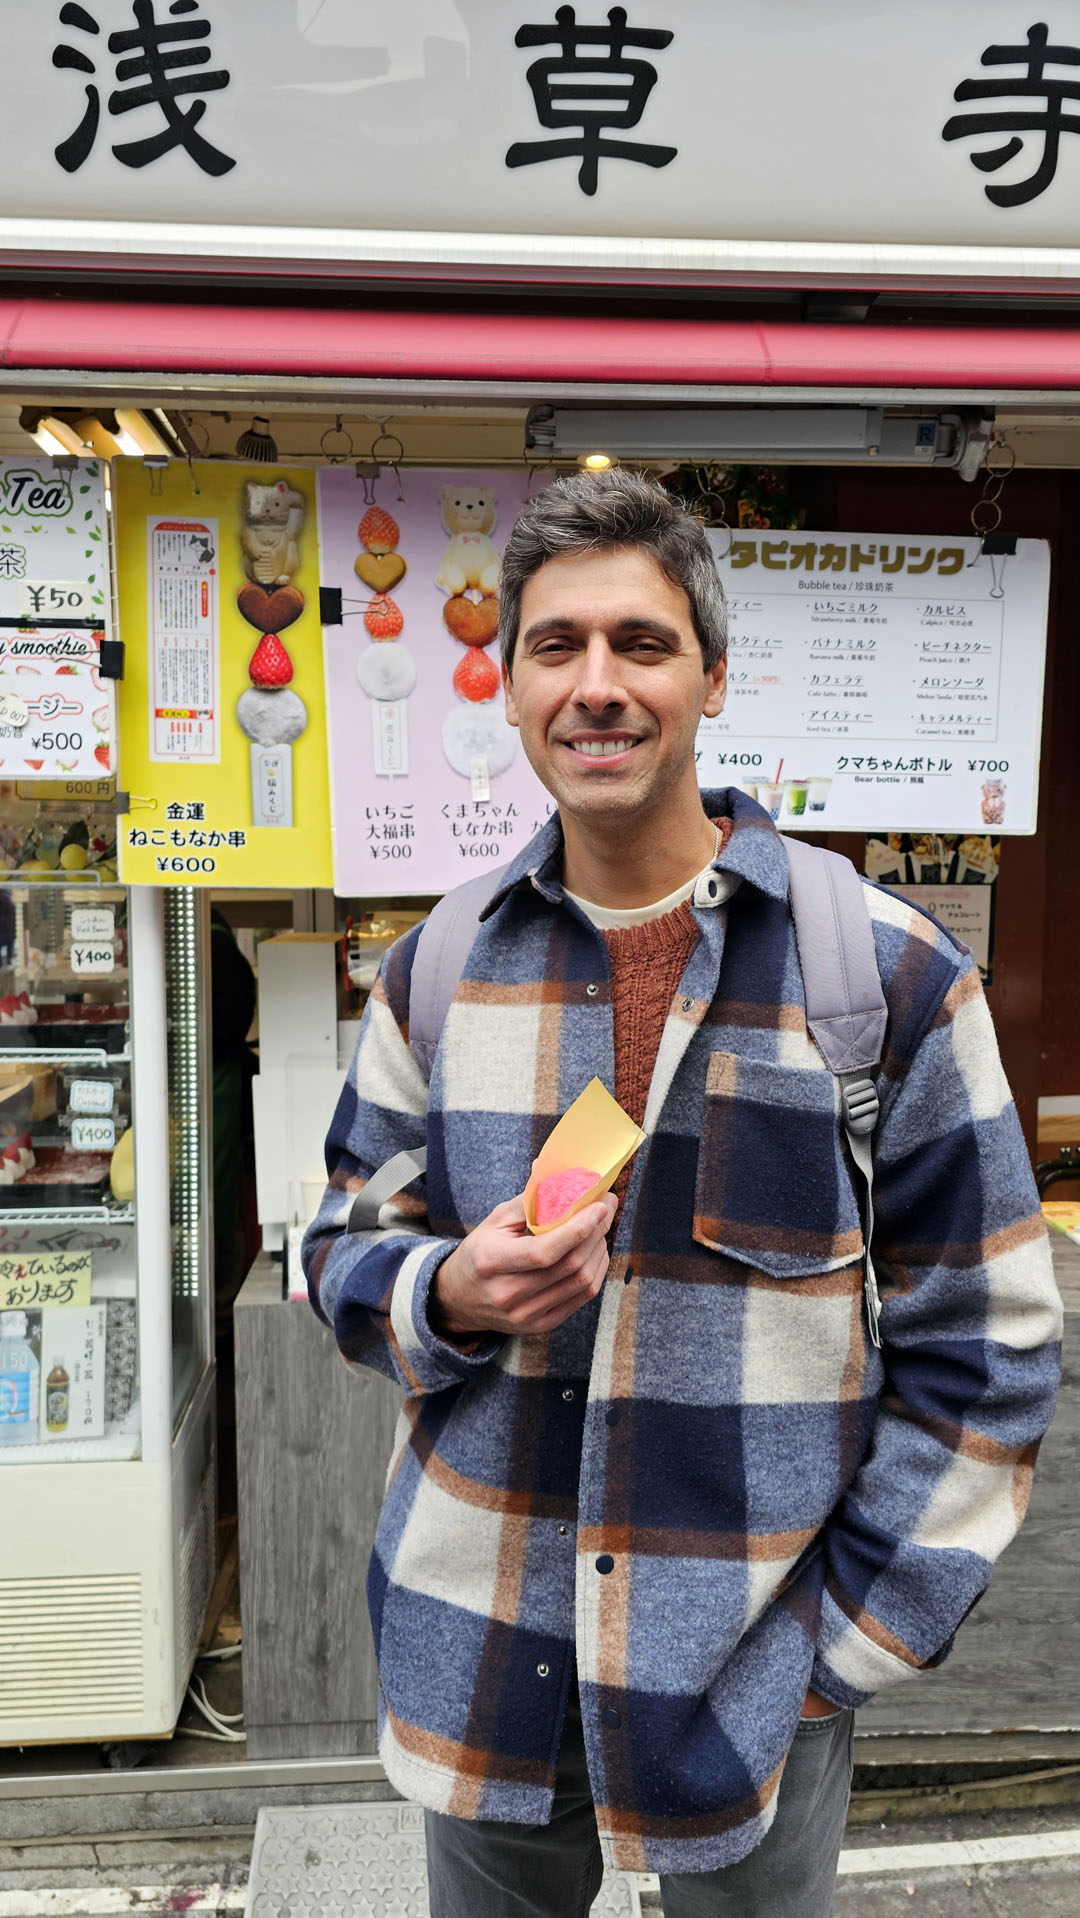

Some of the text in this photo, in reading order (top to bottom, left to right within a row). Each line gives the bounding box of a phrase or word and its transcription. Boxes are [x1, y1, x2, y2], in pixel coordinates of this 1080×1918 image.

[51, 0, 1080, 208] 浅草寺
[11, 476, 66, 509] Tea
[730, 540, 965, 575] タピオカドリンク
[798, 580, 830, 590] Bubble
[833, 581, 847, 591] tea
[855, 582, 894, 592] 珍珠奶茶
[27, 585, 83, 612] ¥50
[727, 601, 763, 609] ティー
[814, 601, 878, 613] いちごミルク
[11, 636, 87, 655] smoothie
[812, 638, 877, 649] バナナミルク
[811, 674, 864, 685] カフェラテ
[920, 677, 985, 688] メロンソーダ
[809, 711, 873, 721] アイスティー
[920, 714, 993, 723] キャラメルティー
[32, 732, 83, 750] ¥500
[718, 753, 763, 766] ¥400
[837, 756, 953, 772] クマちゃんボトル
[967, 760, 1009, 773] ¥700
[876, 776, 900, 784] bottle
[65, 781, 110, 795] 600 円
[166, 802, 205, 820] 金運
[365, 804, 415, 819] いちご
[440, 803, 521, 818] くまちゃん
[365, 823, 415, 840] 大福串
[450, 821, 513, 837] もなか串
[129, 828, 246, 848] ねこもなか串
[370, 845, 412, 860] ¥500
[459, 842, 500, 857] ¥600
[156, 856, 216, 872] ¥600
[6, 1278, 78, 1306] あります
